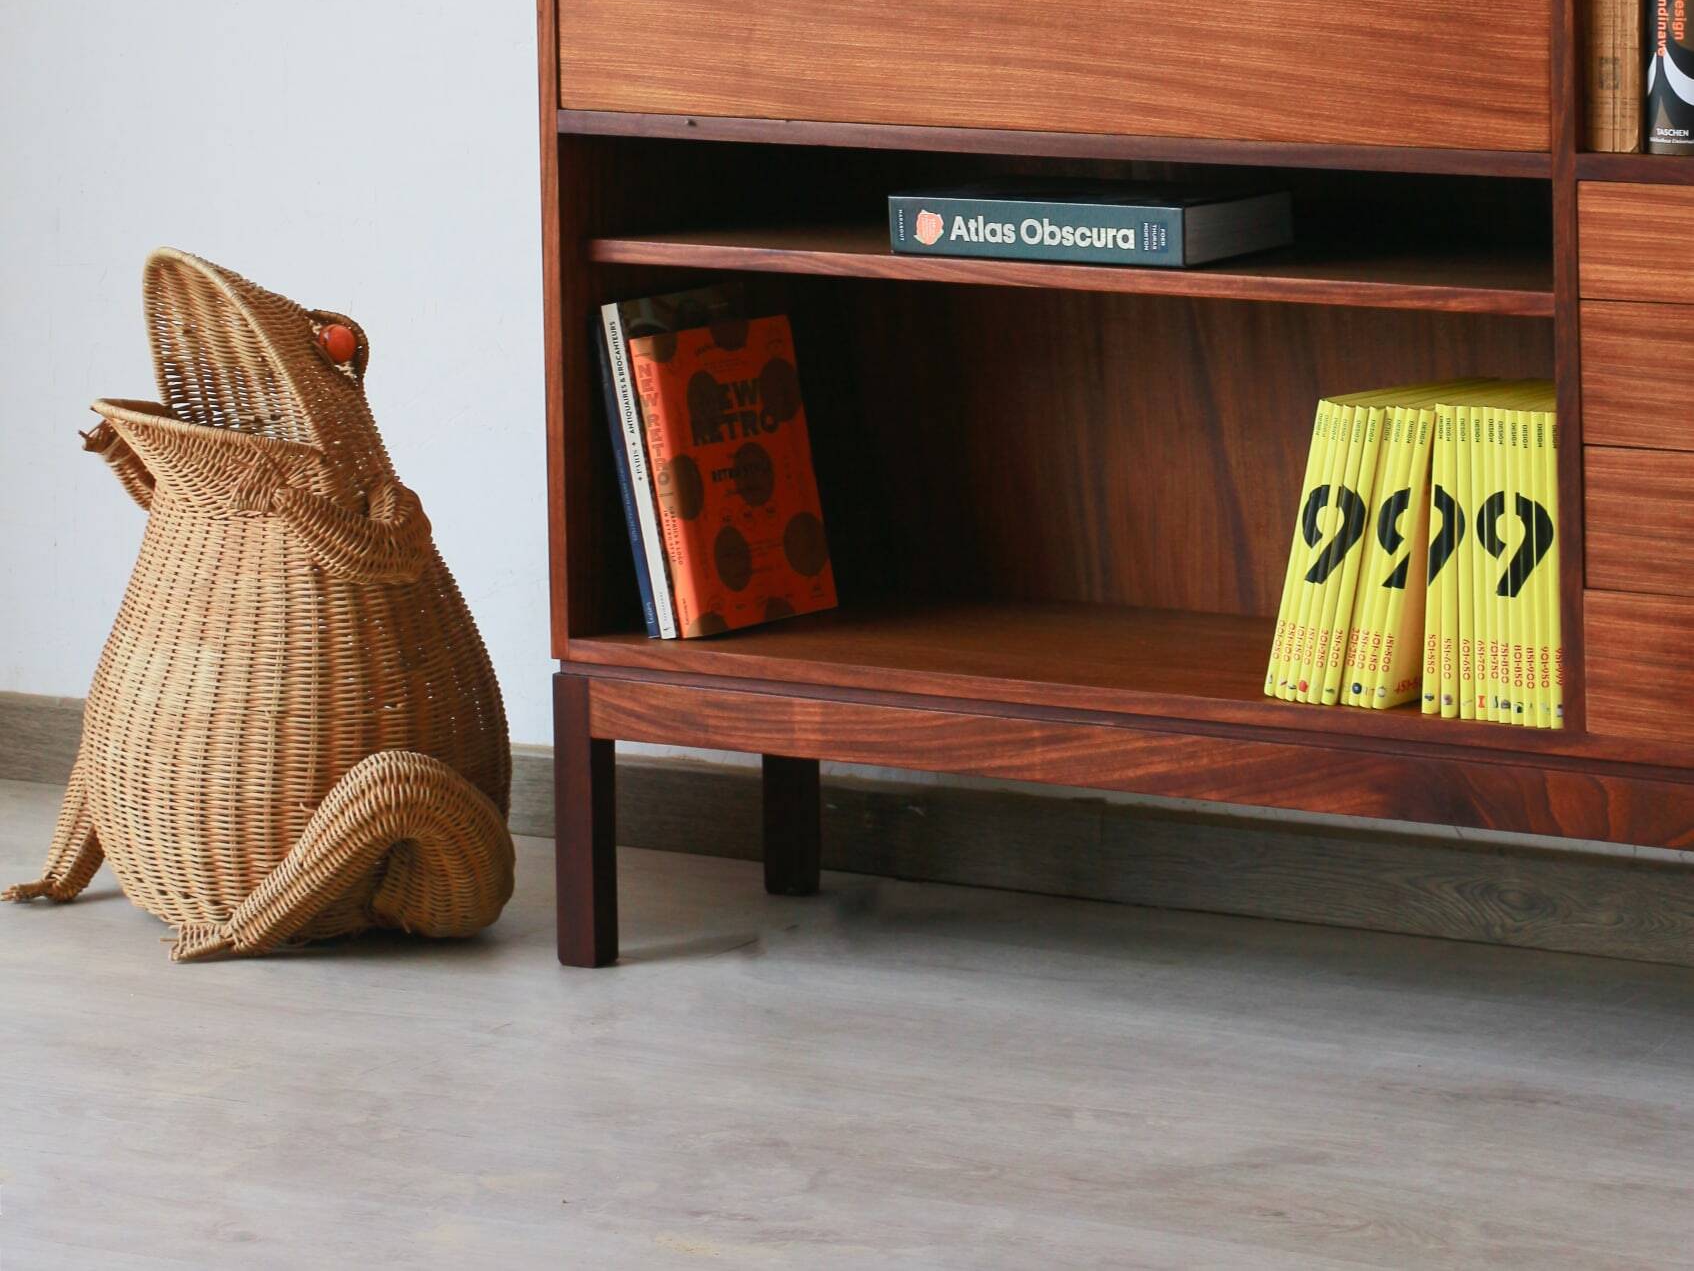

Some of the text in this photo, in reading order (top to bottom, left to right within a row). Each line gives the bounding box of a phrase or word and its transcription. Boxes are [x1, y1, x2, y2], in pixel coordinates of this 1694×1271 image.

[1656, 128, 1690, 136] TASCHEN
[950, 215, 1136, 250] Atlas Obscura
[610, 320, 625, 377] BROCANTEURS
[622, 384, 635, 435] ANTIQUAIRES
[638, 363, 670, 486] NEW RETRO
[1427, 634, 1436, 674] 501-550
[1443, 638, 1452, 680] 551-600
[1462, 638, 1471, 681] 601-650
[1477, 640, 1486, 680] 651-700
[1490, 639, 1499, 680] 701-750
[1500, 642, 1510, 684] 751-800
[1514, 644, 1523, 688] 801-850
[1526, 647, 1536, 690] 851-900
[1540, 646, 1550, 688] 901-950
